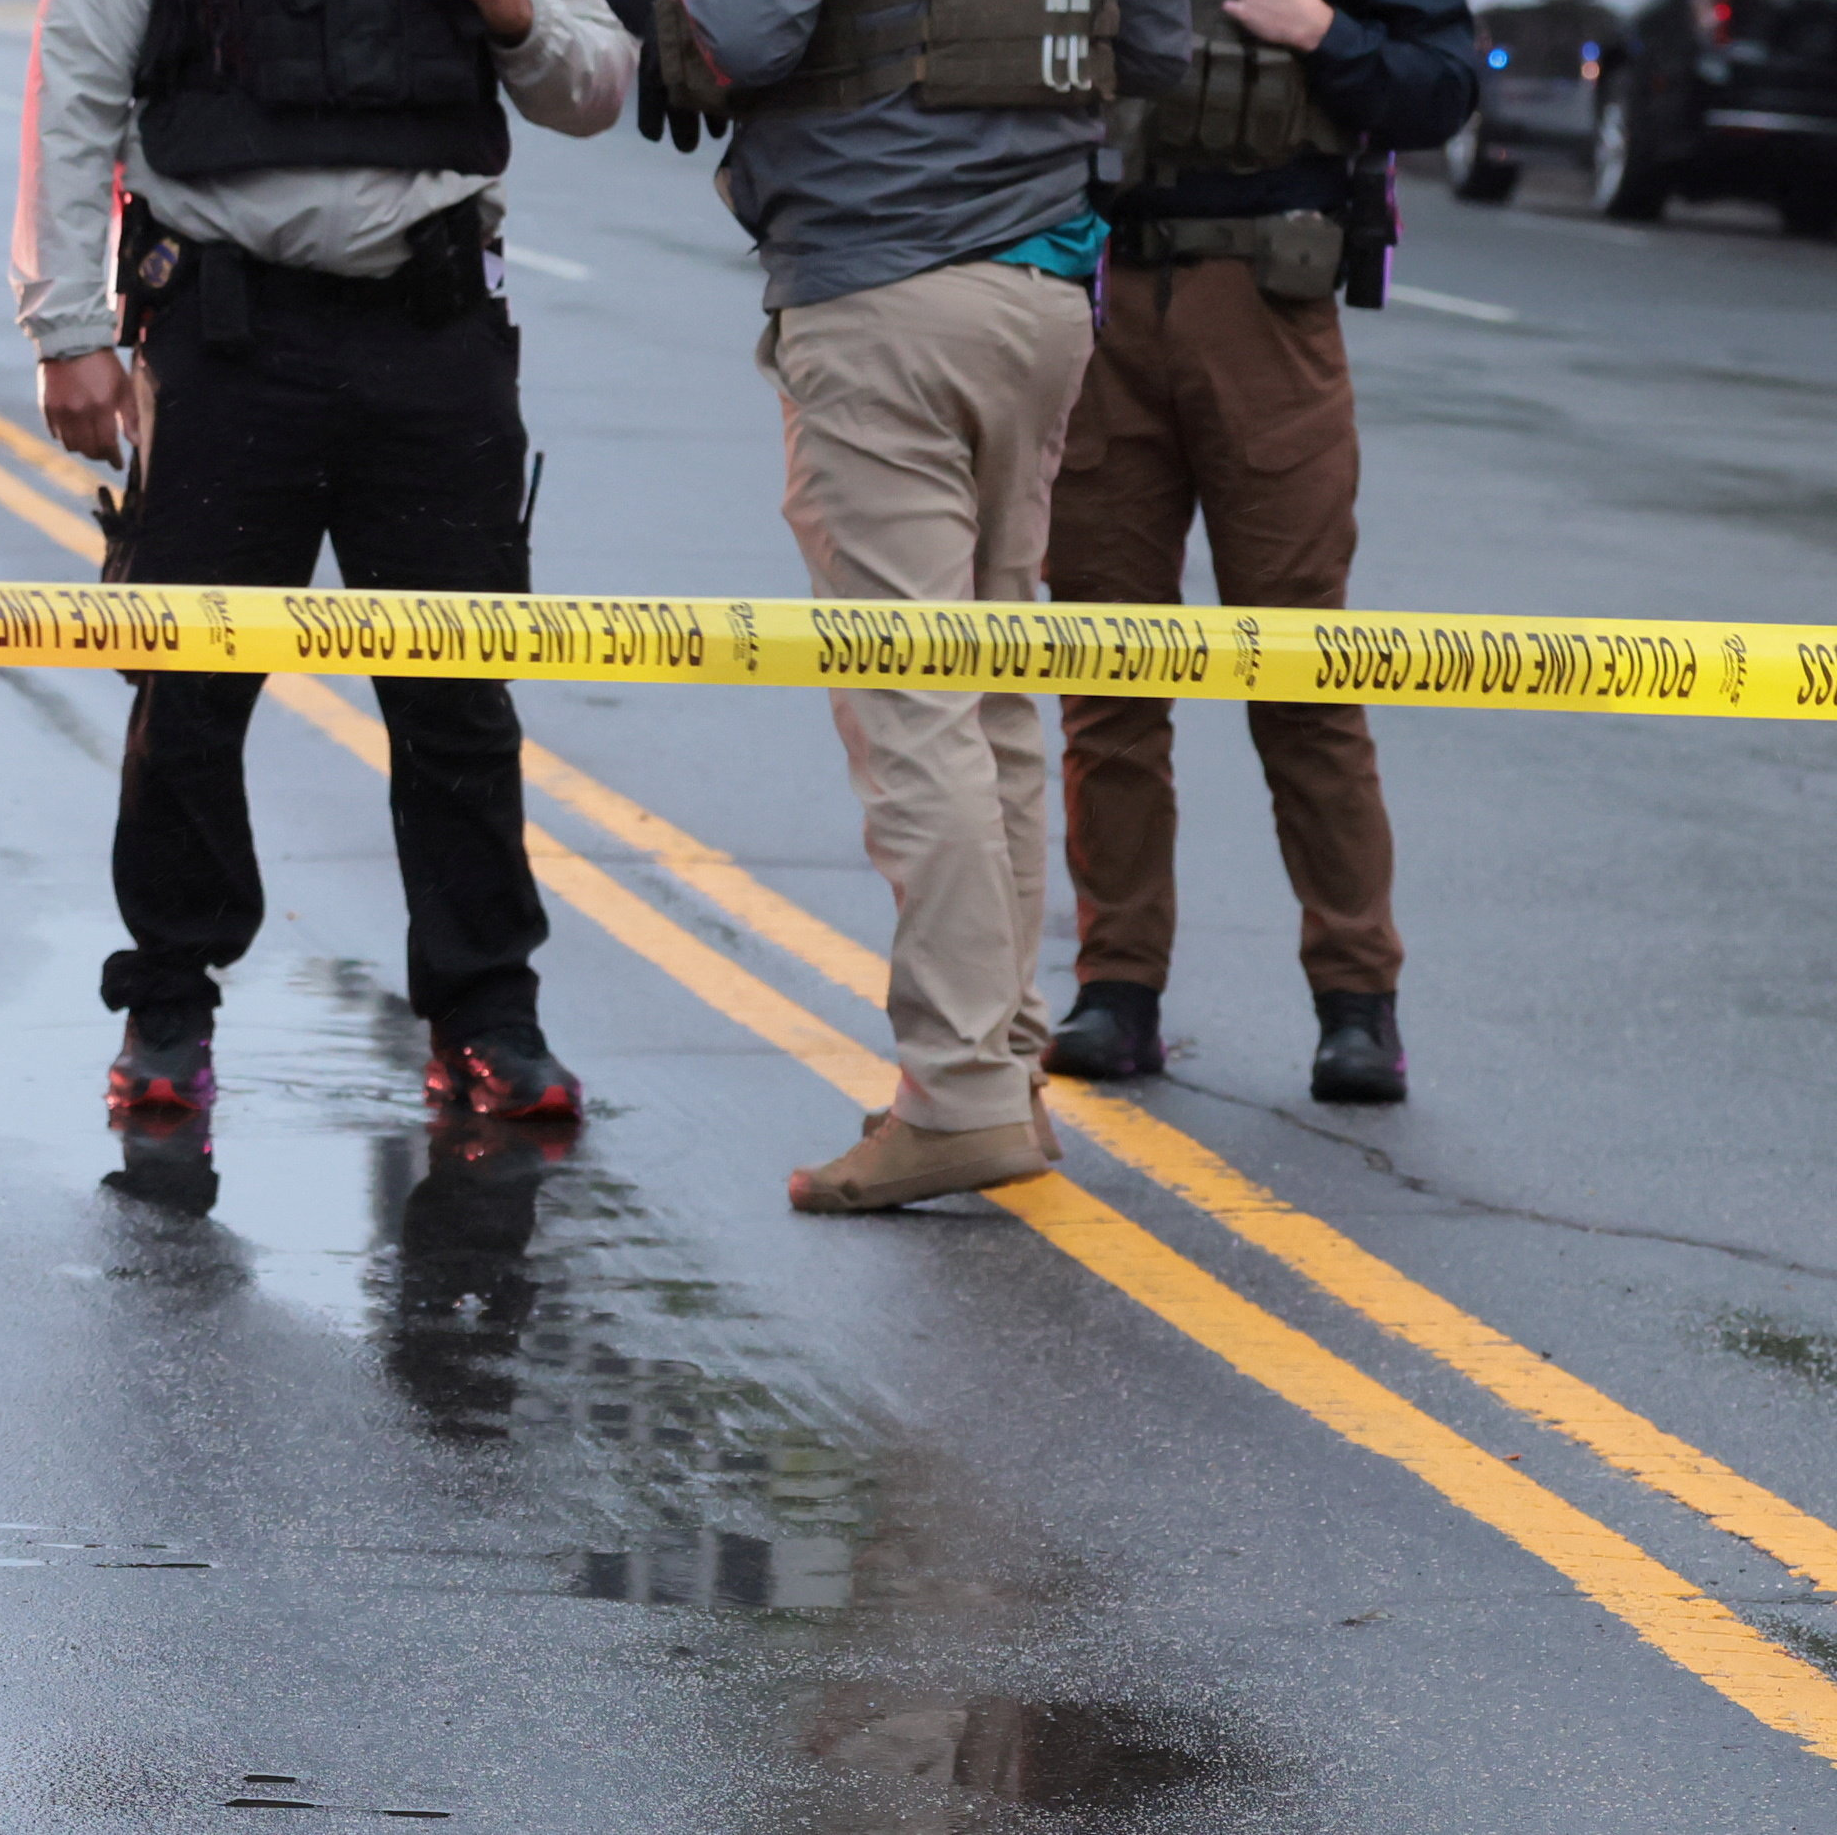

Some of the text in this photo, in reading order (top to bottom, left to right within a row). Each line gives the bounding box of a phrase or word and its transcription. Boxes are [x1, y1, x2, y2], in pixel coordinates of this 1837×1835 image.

[56, 590, 180, 653] POLICE
[283, 595, 397, 661] CROSS
[400, 598, 467, 662] NOT
[467, 599, 518, 664] DO
[516, 600, 593, 664] LINE
[589, 601, 706, 668] POLICE
[810, 607, 916, 677] CROSS
[918, 611, 983, 678] NOT
[985, 612, 1033, 679] DO
[1032, 614, 1105, 680] LINE
[1103, 616, 1211, 684] POLICE
[1313, 624, 1413, 692] CROSS
[1413, 628, 1476, 694] NOT
[1480, 629, 1523, 695] DO
[1525, 632, 1594, 696] LINE
[1595, 634, 1698, 700] POLICE
